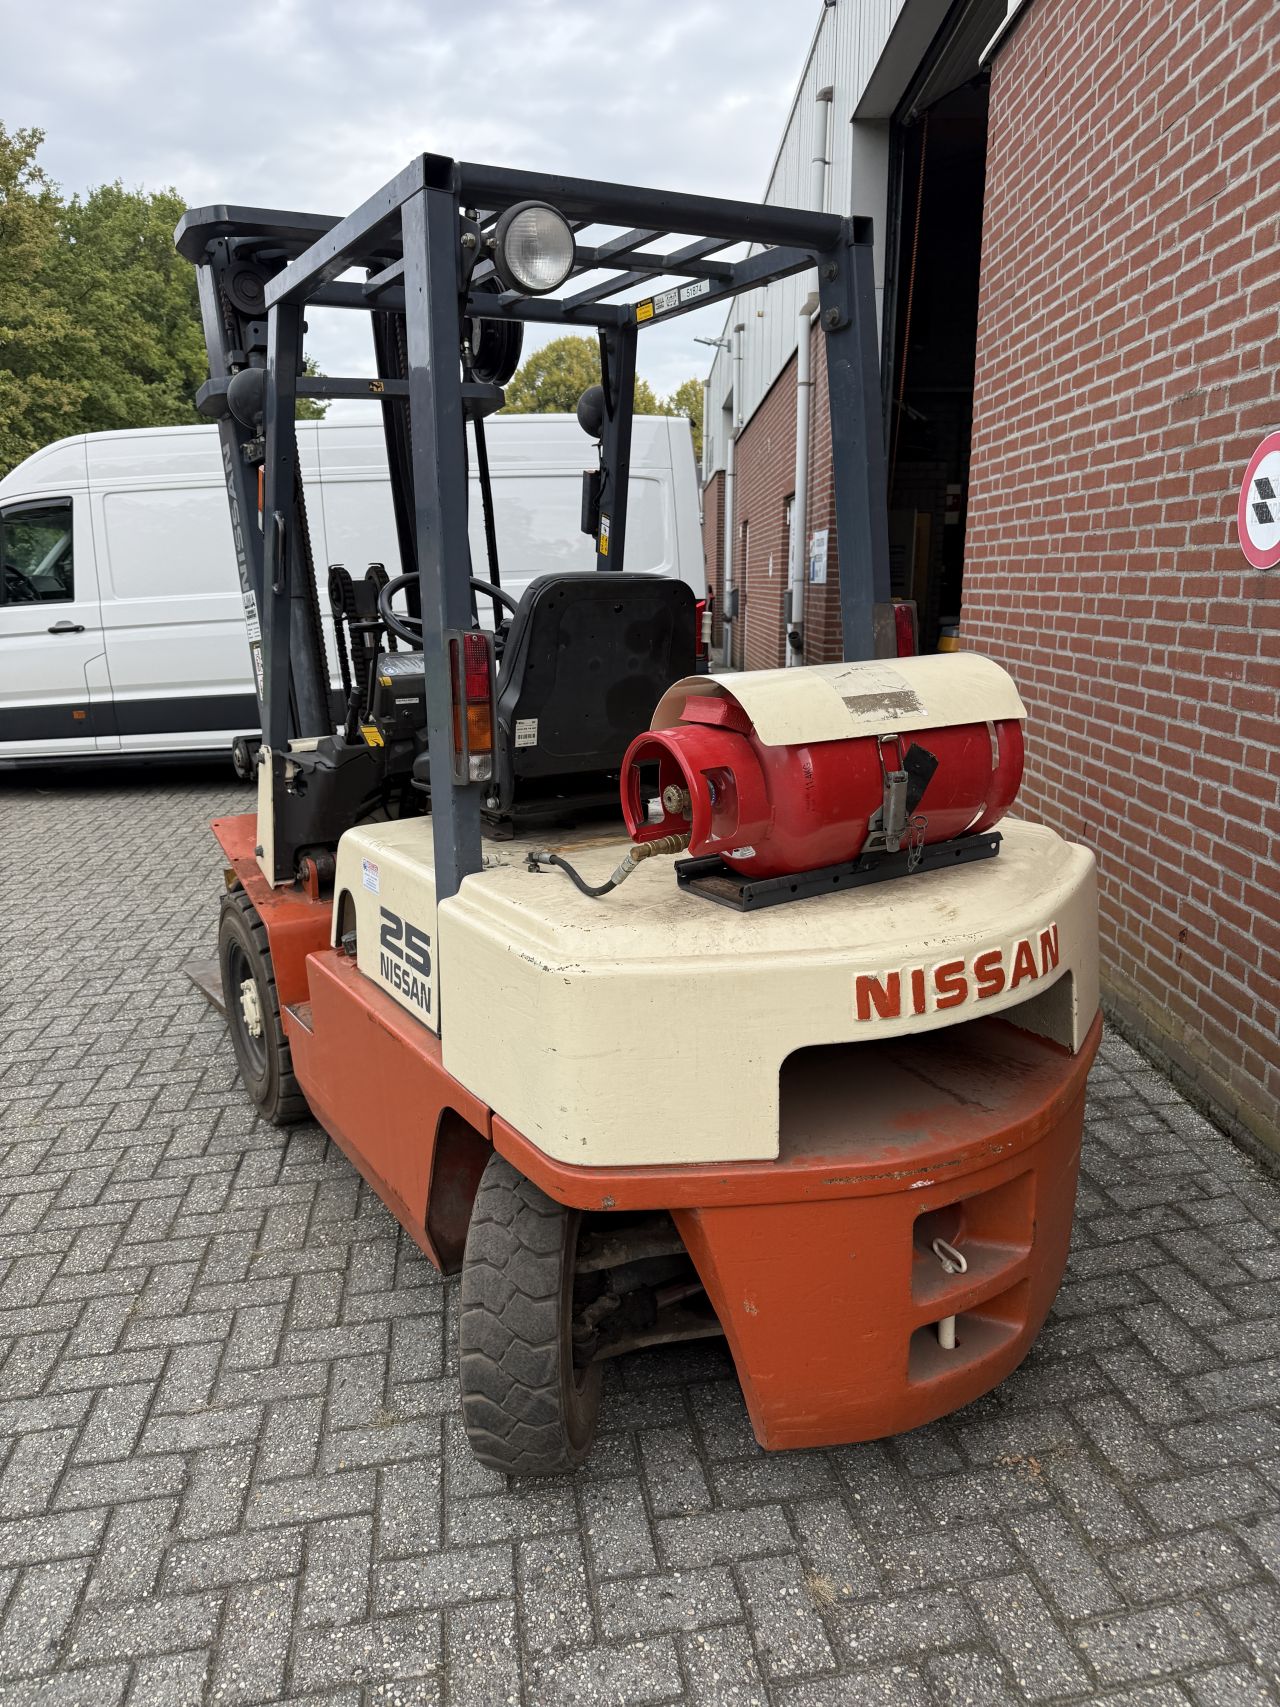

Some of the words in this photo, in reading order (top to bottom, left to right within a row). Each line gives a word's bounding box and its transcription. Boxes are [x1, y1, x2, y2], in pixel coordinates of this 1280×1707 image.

[222, 442, 250, 593] NISSAN
[380, 906, 432, 978] 25
[380, 951, 432, 1015] NISSAN
[855, 921, 1060, 1022] NISSAN
